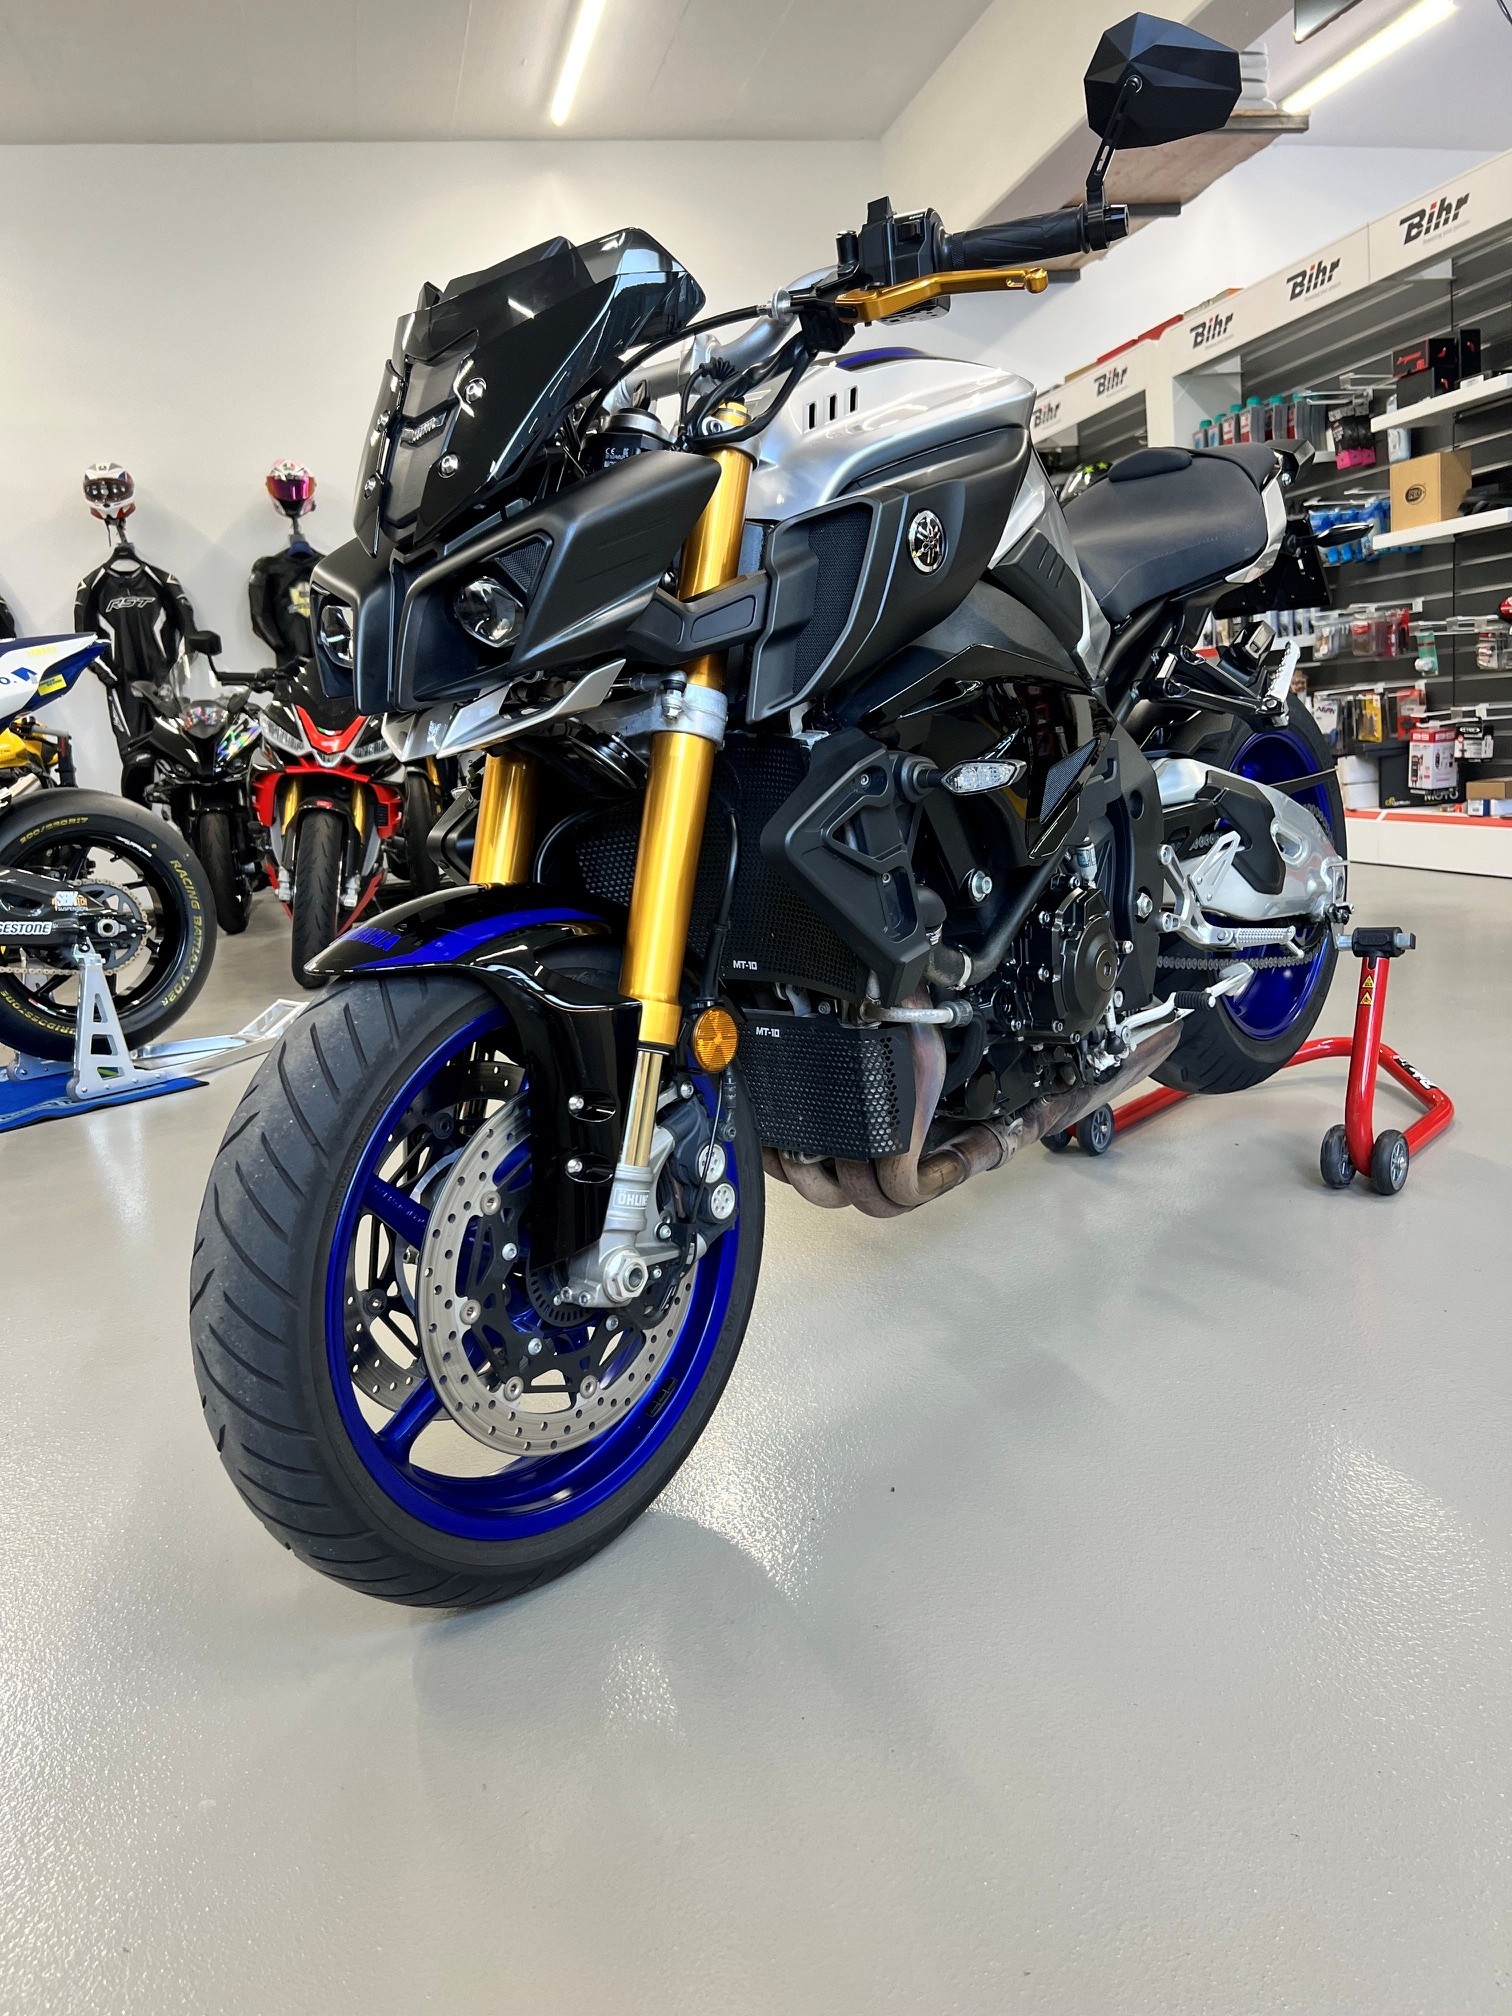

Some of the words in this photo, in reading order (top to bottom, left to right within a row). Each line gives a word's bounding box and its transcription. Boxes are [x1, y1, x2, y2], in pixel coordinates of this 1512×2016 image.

[1399, 192, 1470, 245] Bihr
[1286, 256, 1341, 301] Bihr
[1189, 312, 1234, 349] Bihr
[1093, 366, 1128, 397] Bihr
[1032, 403, 1061, 428] Bihr
[105, 596, 156, 613] RST
[169, 859, 201, 910] RACING
[732, 959, 758, 971] MT-10
[755, 1026, 780, 1038] MT-10
